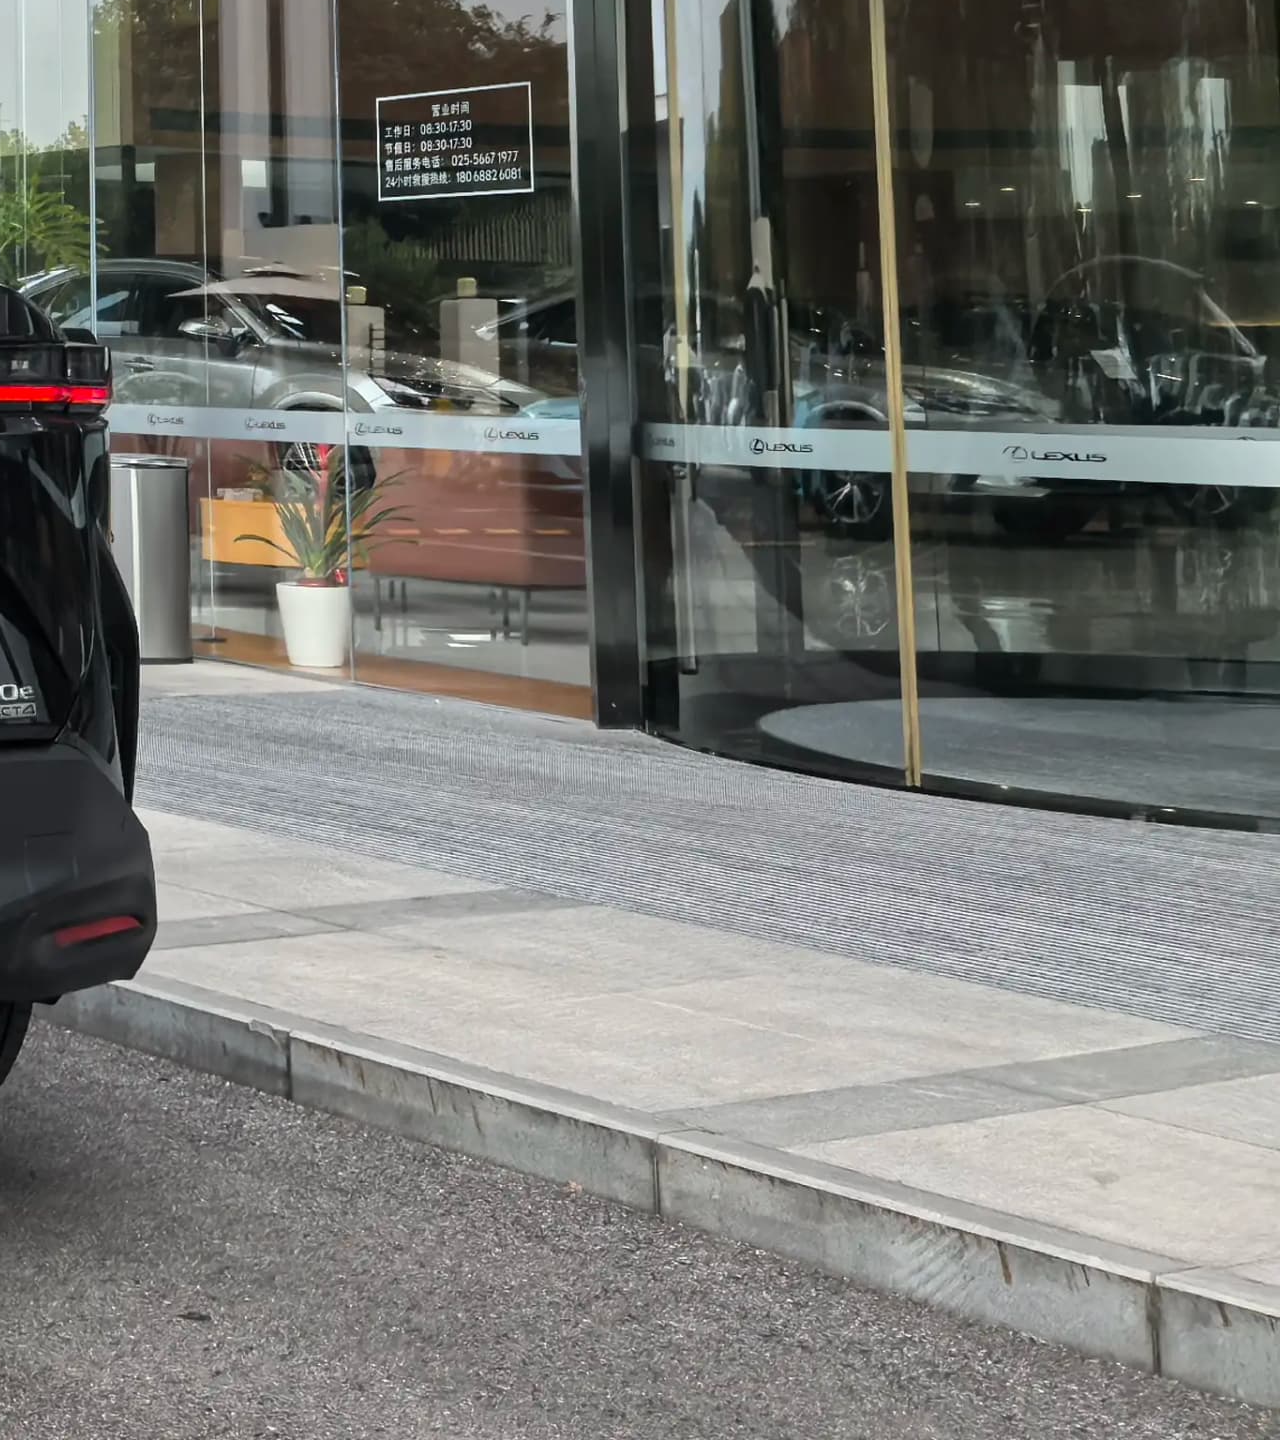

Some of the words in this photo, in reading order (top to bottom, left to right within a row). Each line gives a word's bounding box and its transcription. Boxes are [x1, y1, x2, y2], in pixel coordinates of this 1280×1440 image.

[431, 101, 471, 117] 营业时间
[419, 119, 472, 135] 08:30-17:30
[420, 137, 473, 152] 08:30-17:30
[499, 430, 540, 440] LEXUS
[765, 442, 814, 453] LEXUS
[1030, 450, 1108, 462] LEXUS
